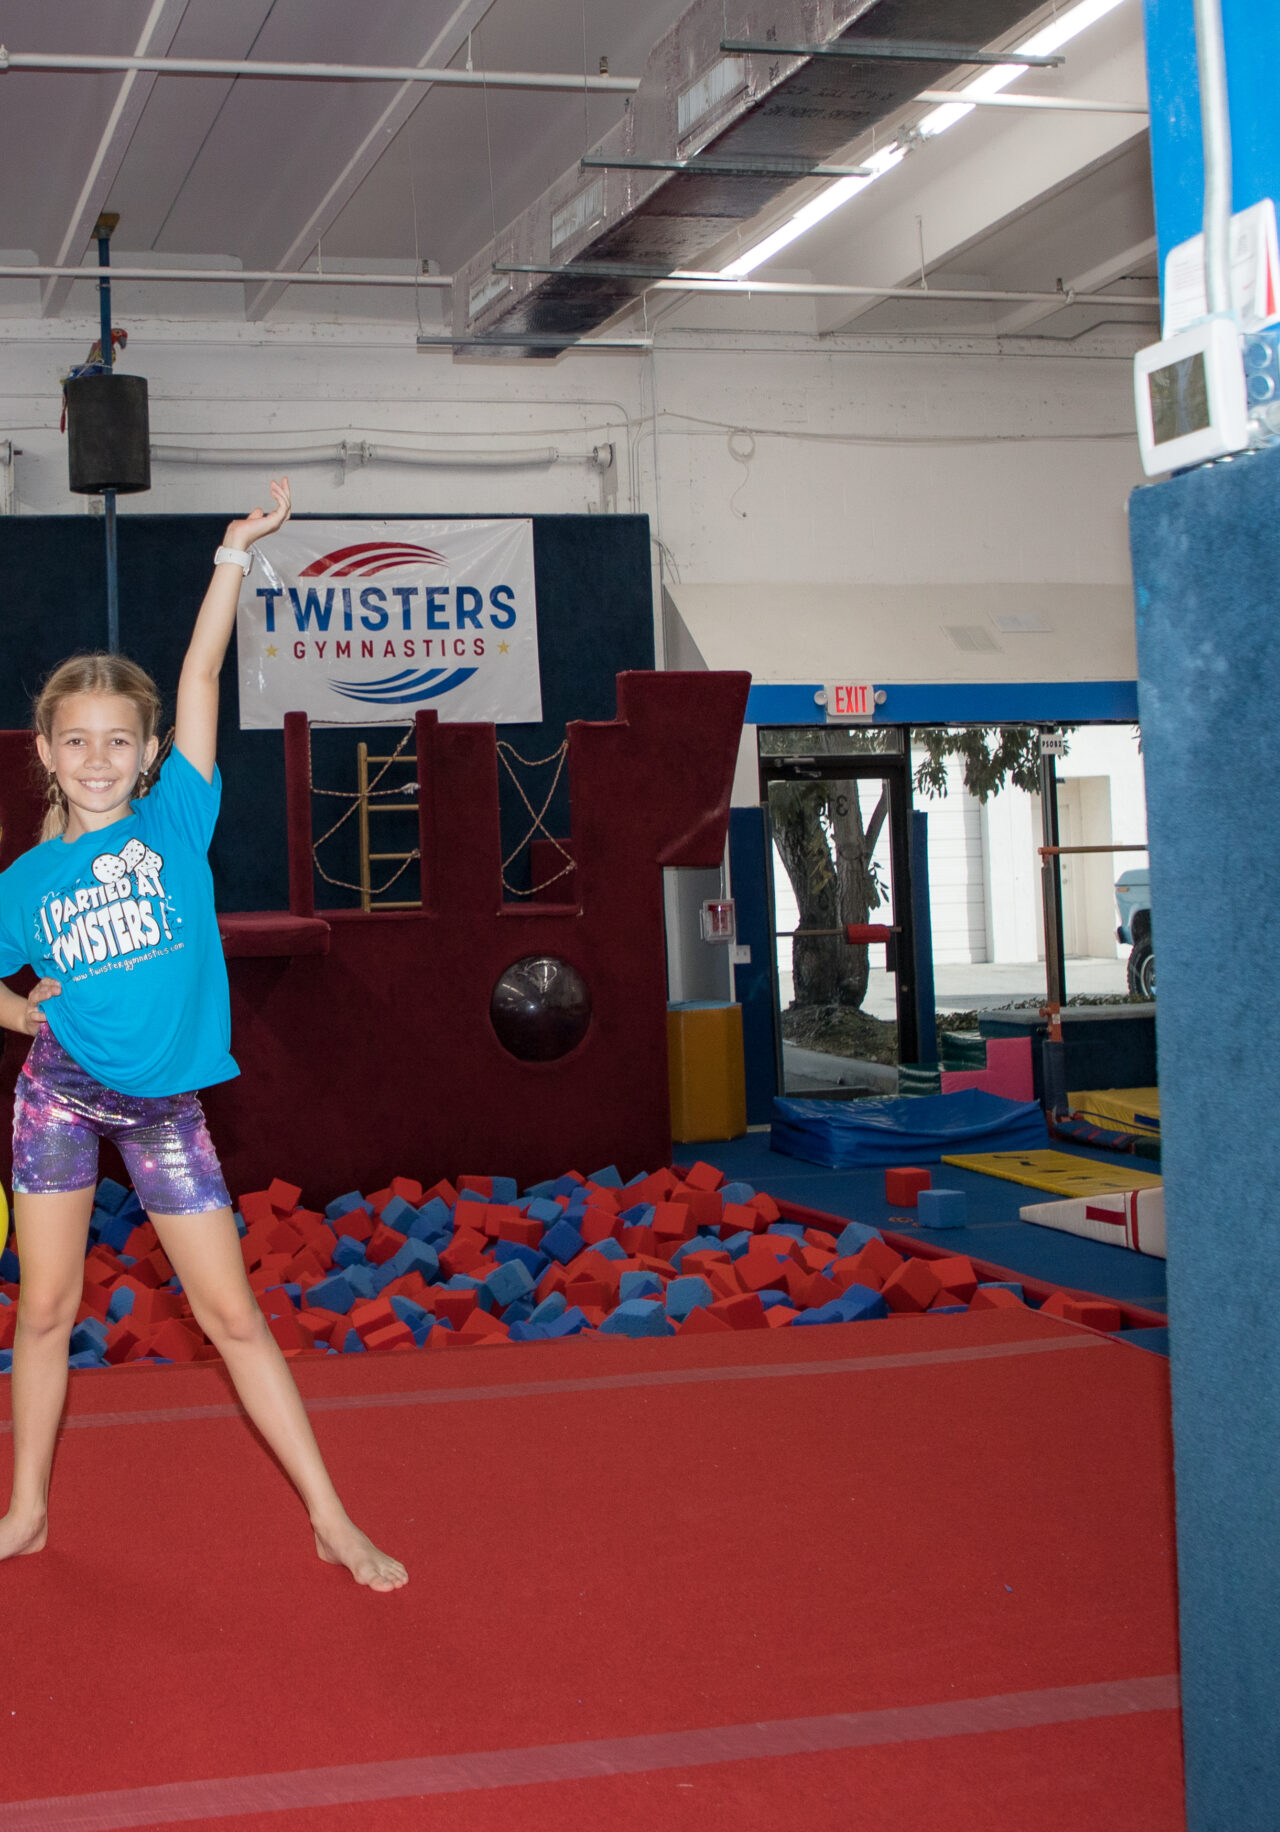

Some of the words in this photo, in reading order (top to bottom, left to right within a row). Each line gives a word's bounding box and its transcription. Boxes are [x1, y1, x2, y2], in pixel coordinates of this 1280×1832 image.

[256, 584, 517, 633] TWISTERS
[293, 638, 485, 659] GYMNASTICS
[835, 686, 868, 713] EXIT
[40, 906, 54, 945] I
[50, 878, 132, 934] PARTIED
[138, 867, 166, 899] AT
